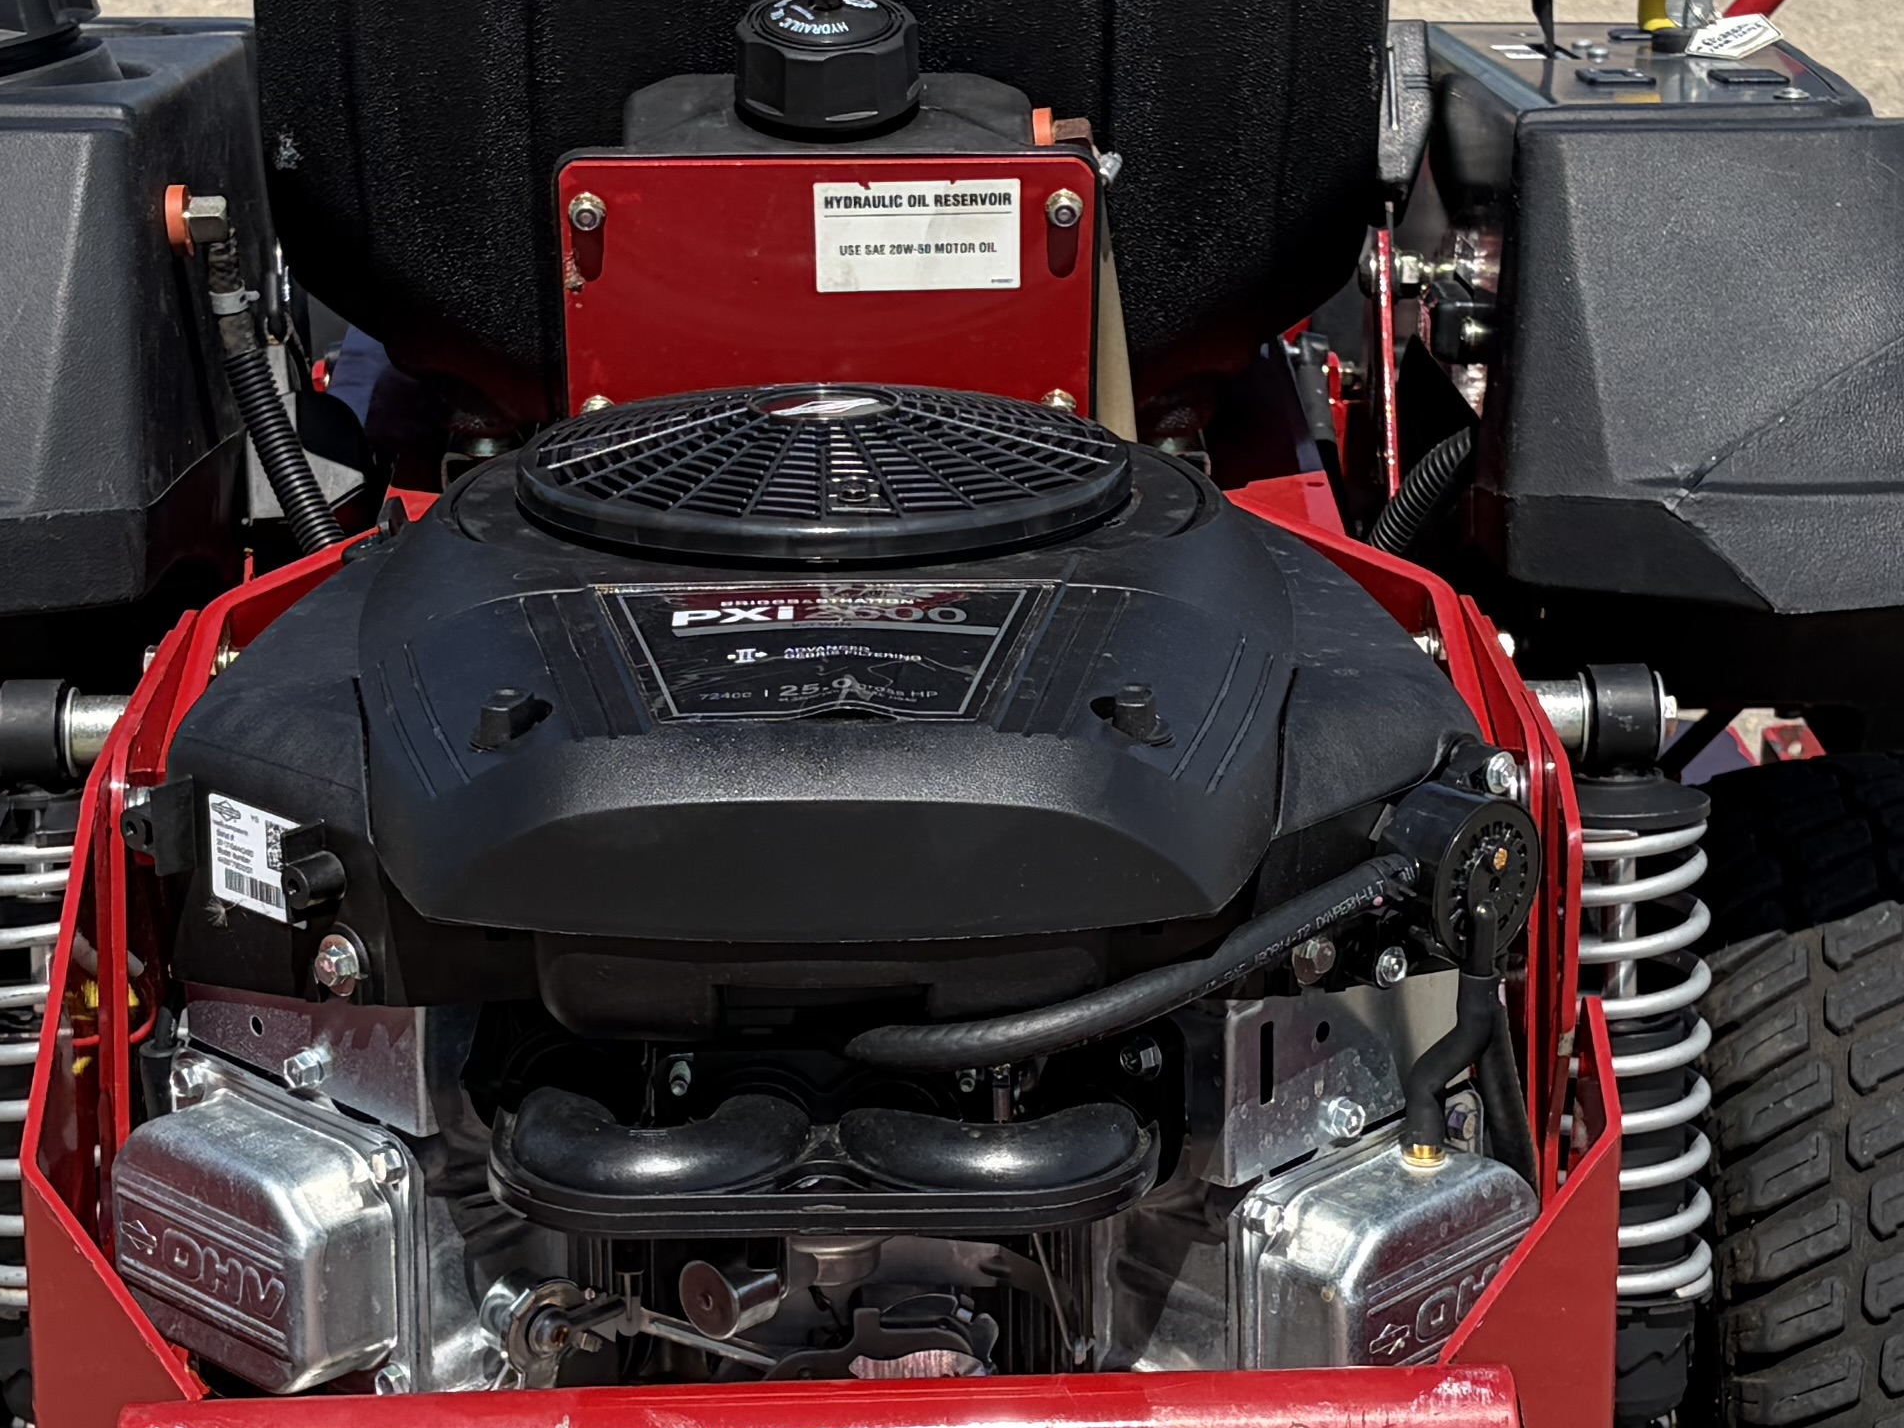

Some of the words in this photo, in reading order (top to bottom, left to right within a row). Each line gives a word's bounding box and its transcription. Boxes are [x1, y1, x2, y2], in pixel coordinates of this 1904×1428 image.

[823, 195, 903, 210] HYDRAULIC
[907, 194, 930, 208] OIL
[933, 192, 1012, 207] RESERVOIR
[839, 245, 862, 256] USE
[865, 244, 886, 255] SAE
[889, 243, 932, 255] 20W-50
[934, 243, 976, 254] MOTOR
[979, 242, 997, 253] OIL
[779, 678, 853, 697] 25.0
[911, 690, 938, 698] HP
[160, 1227, 286, 1320] OHV
[1415, 1254, 1510, 1343] OH
